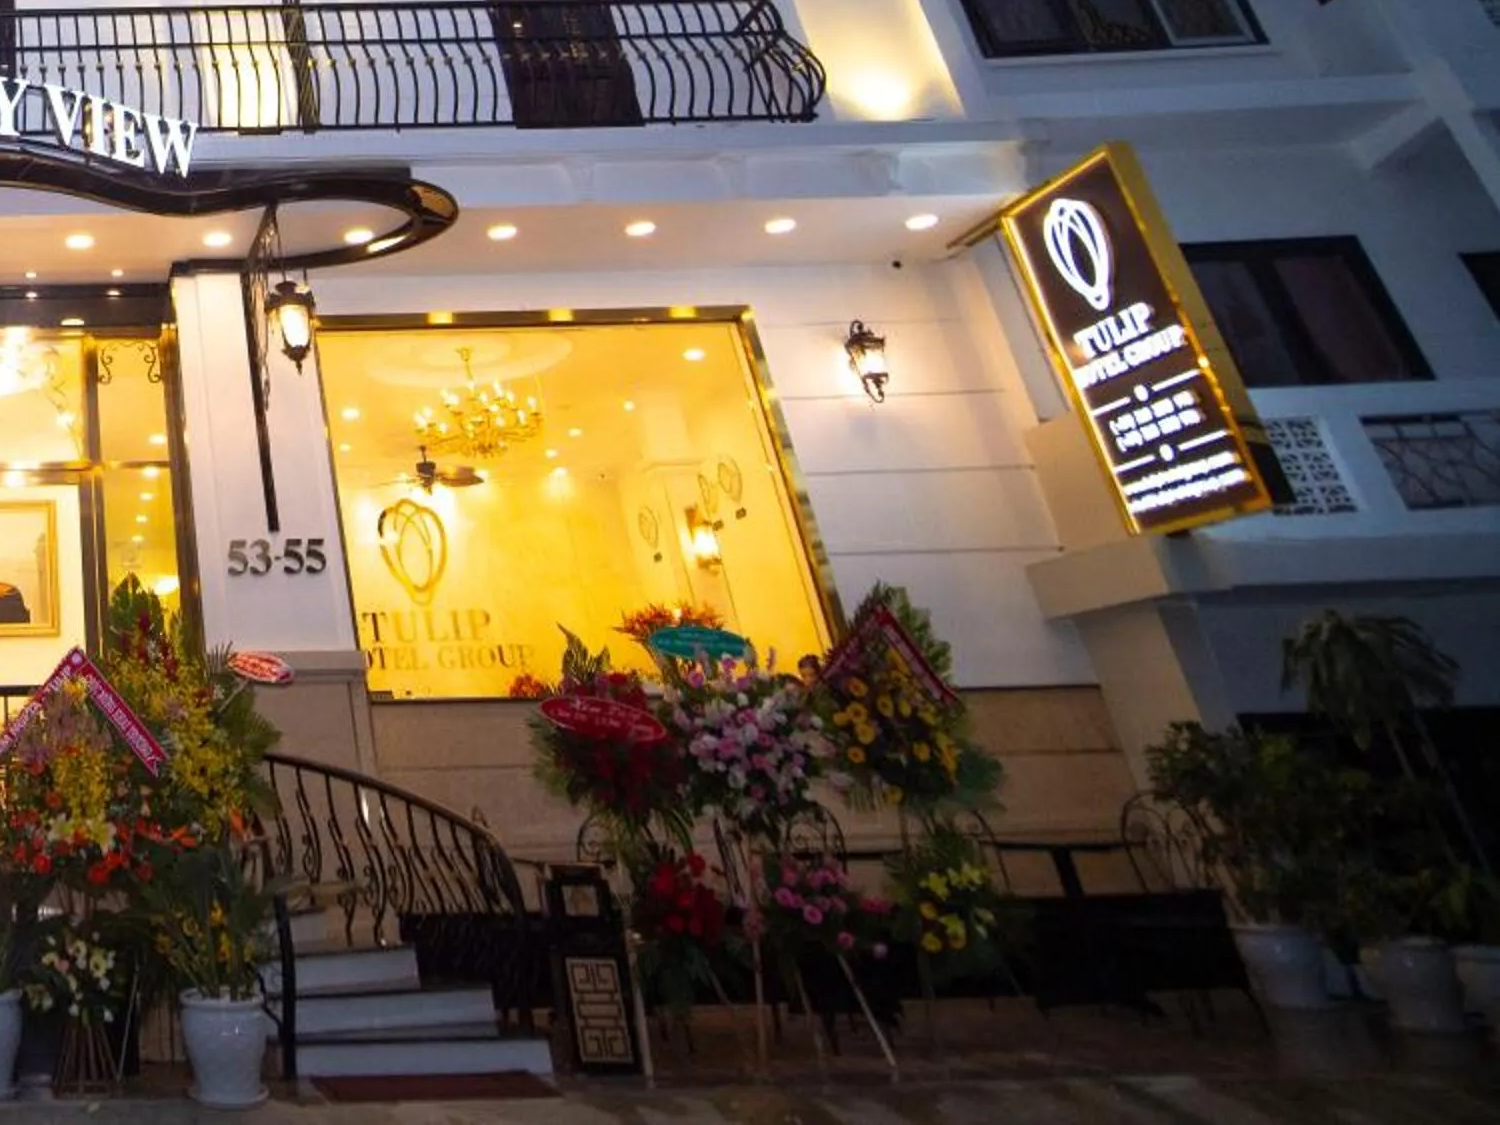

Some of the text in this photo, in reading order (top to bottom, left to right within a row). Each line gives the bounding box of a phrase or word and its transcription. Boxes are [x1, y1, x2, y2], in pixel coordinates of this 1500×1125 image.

[41, 83, 199, 179] VIEW
[1073, 302, 1152, 360] TULIP
[227, 537, 327, 576] 53-55
[361, 608, 492, 644] TULIP
[436, 643, 535, 670] GROUP
